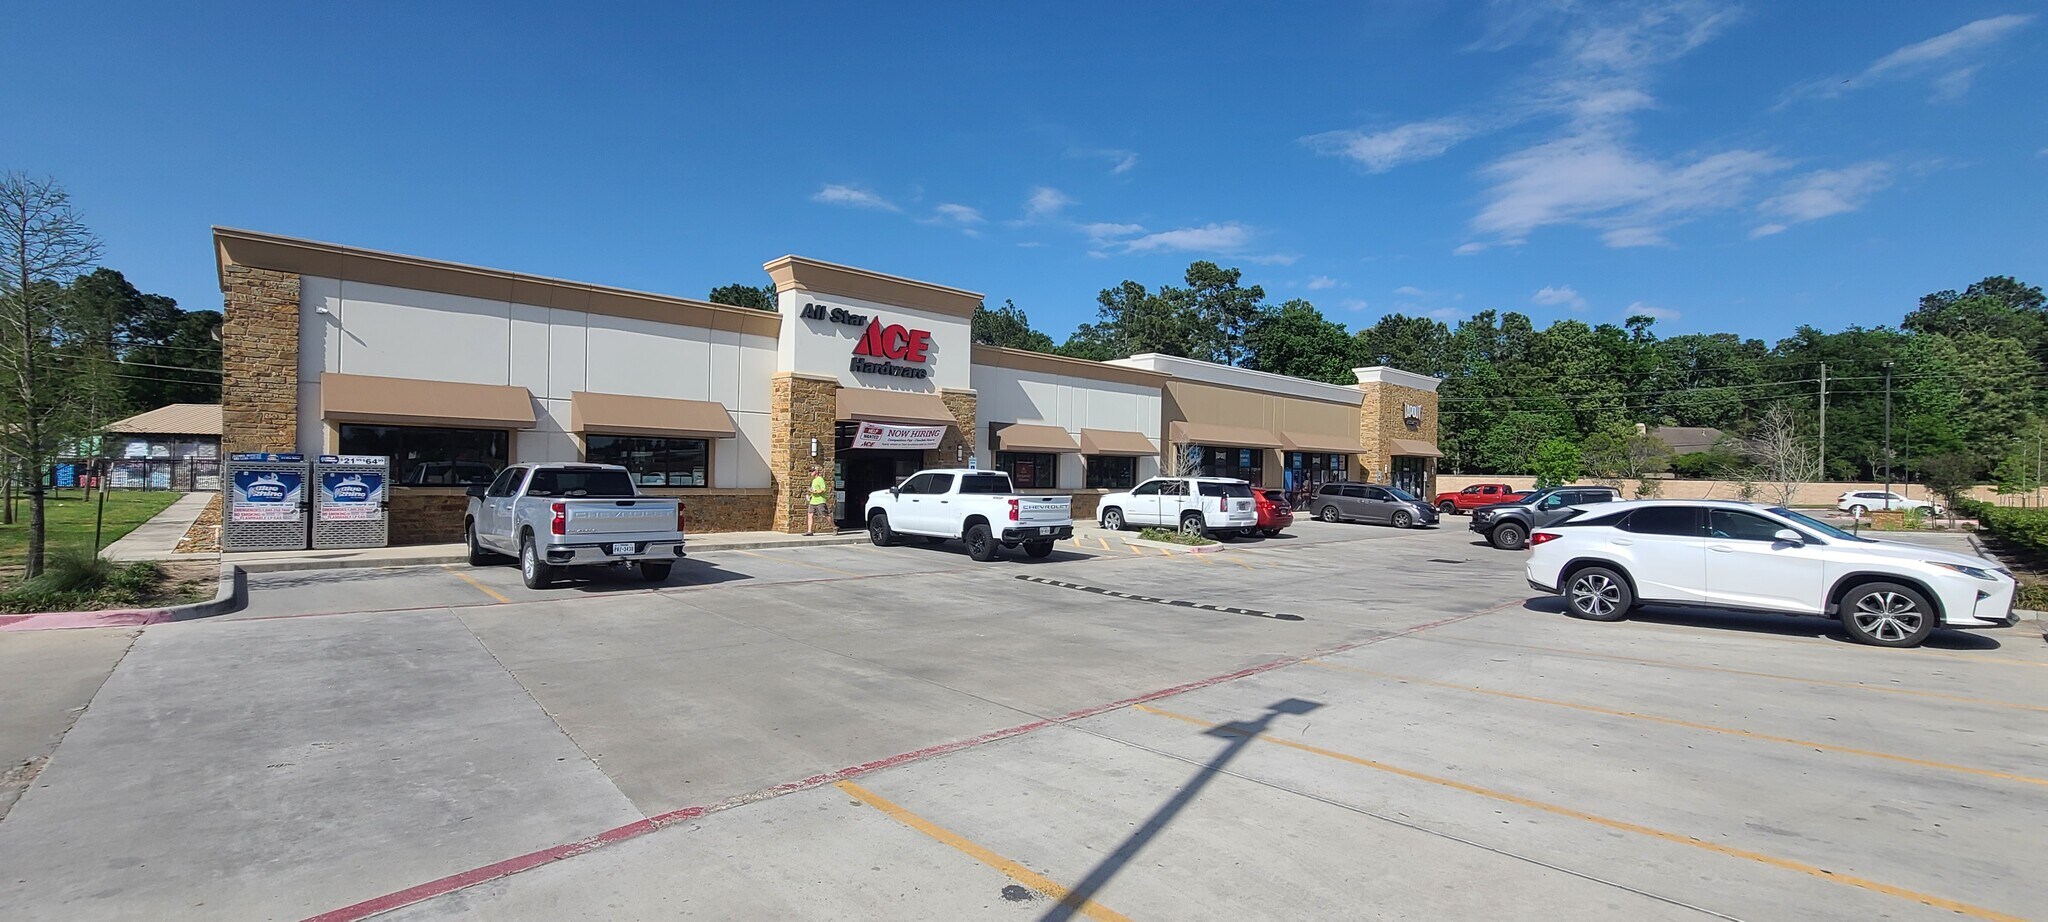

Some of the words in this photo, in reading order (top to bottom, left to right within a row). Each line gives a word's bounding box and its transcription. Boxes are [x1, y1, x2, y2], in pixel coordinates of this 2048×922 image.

[800, 303, 827, 320] All
[830, 307, 867, 326] Star
[852, 315, 931, 362] ACE
[849, 357, 928, 379] Hardware
[887, 429, 910, 438] NOW
[910, 429, 940, 438] HIRING
